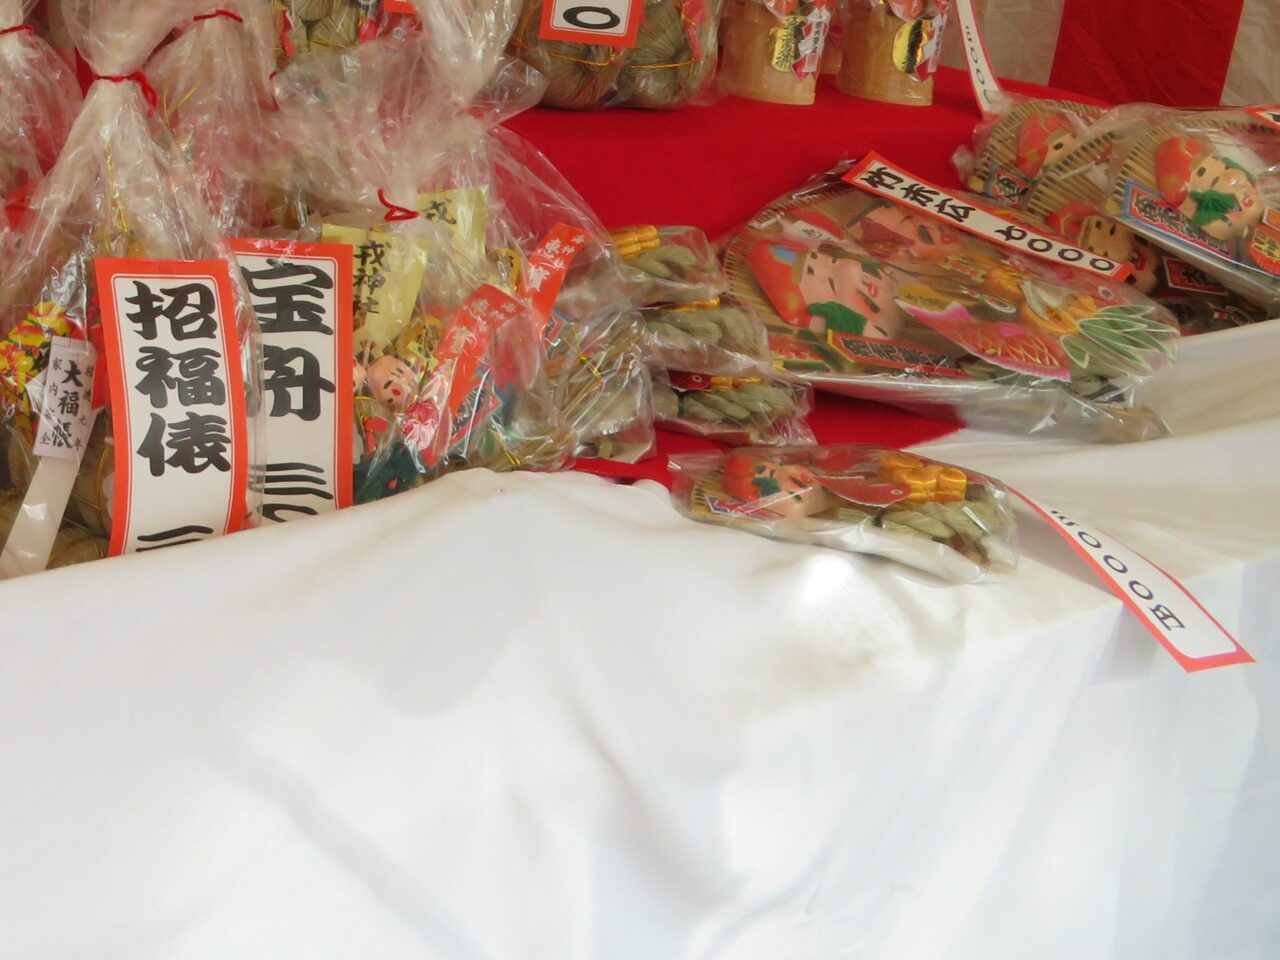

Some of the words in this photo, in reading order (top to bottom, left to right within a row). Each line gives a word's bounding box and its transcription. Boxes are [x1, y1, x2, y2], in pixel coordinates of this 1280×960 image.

[51, 359, 84, 448] 大福帳
[125, 280, 232, 477] 招福俵
[240, 257, 337, 422] 宝舟
